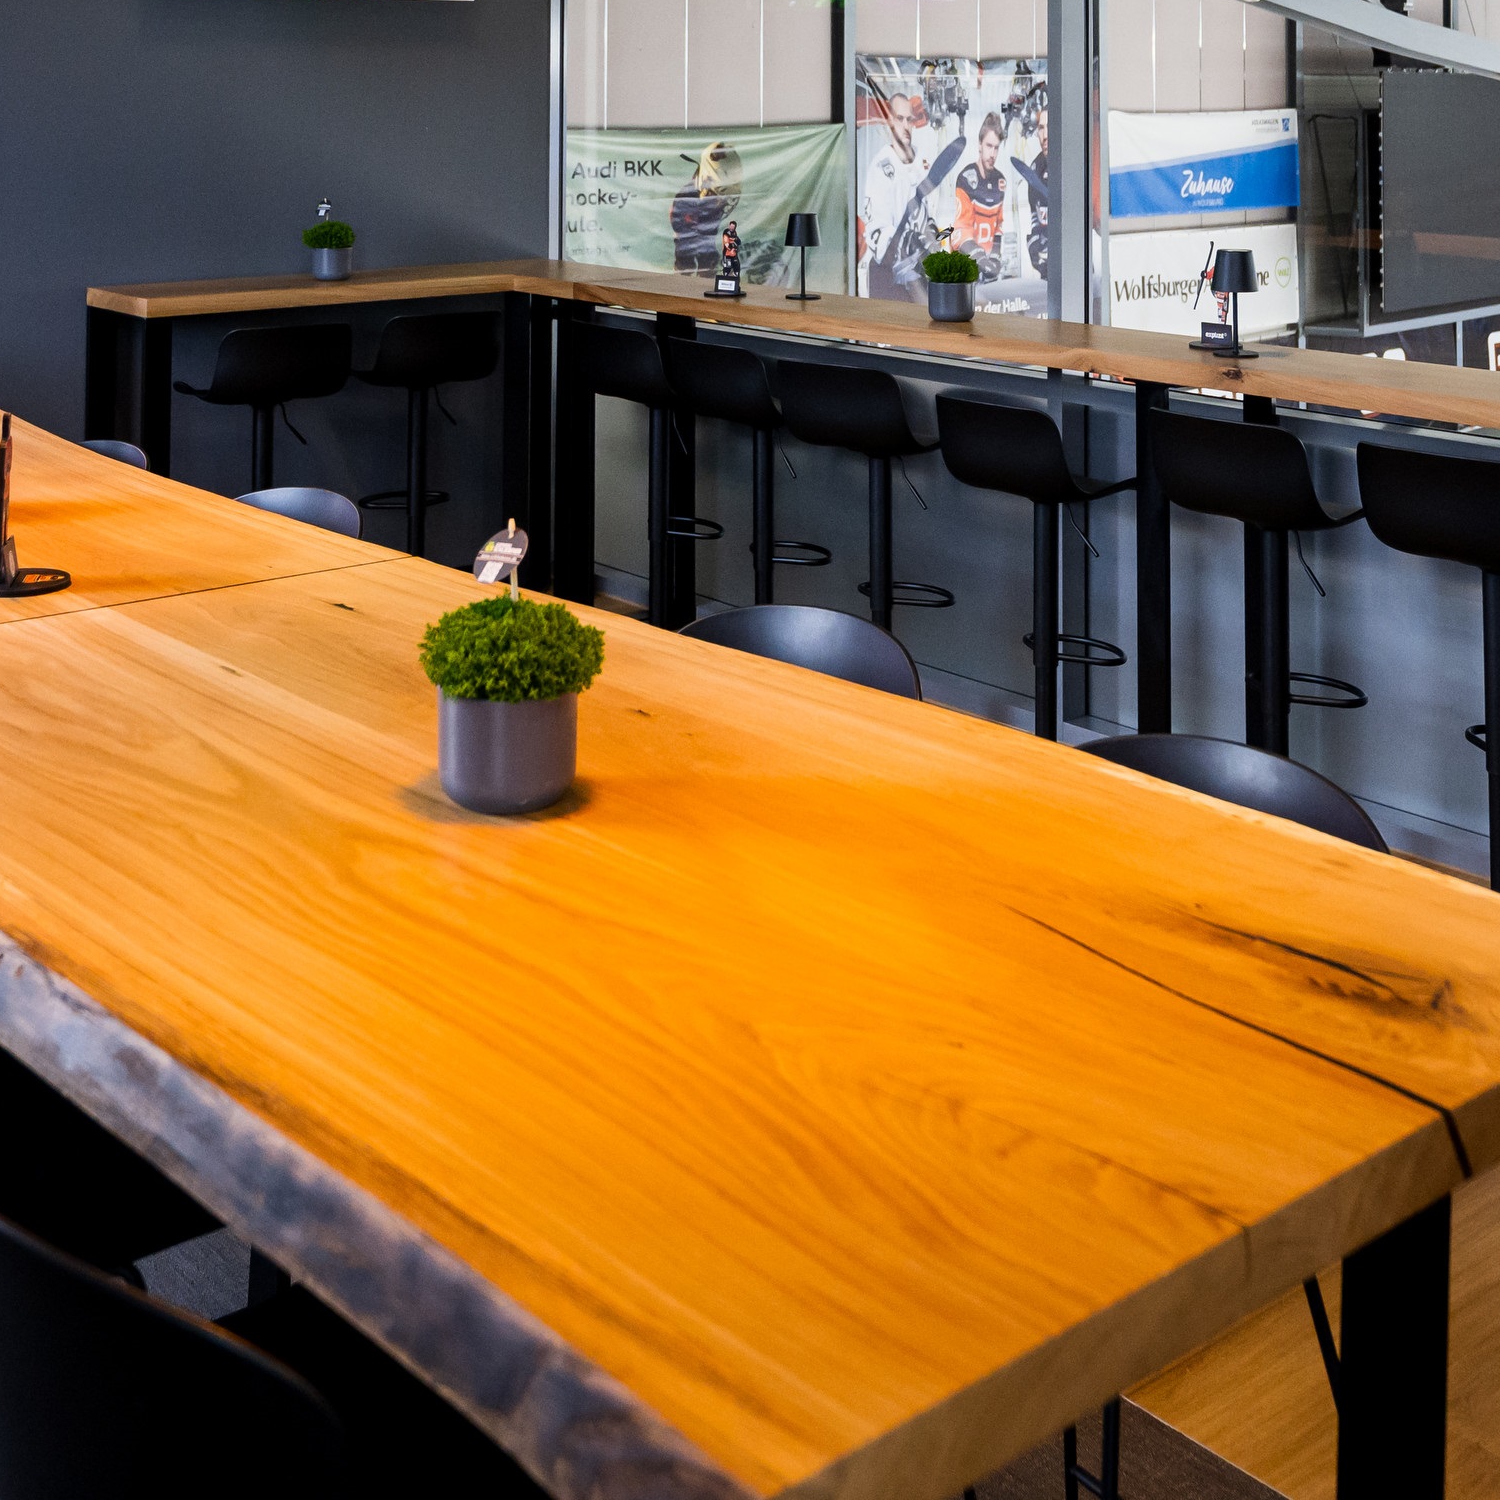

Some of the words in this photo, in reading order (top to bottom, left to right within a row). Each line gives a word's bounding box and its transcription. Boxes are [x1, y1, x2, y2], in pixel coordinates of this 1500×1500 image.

[571, 161, 617, 179] Audi
[624, 159, 663, 177] BKK
[1181, 169, 1235, 198] Zuhause
[1002, 297, 1030, 313] Halle.
